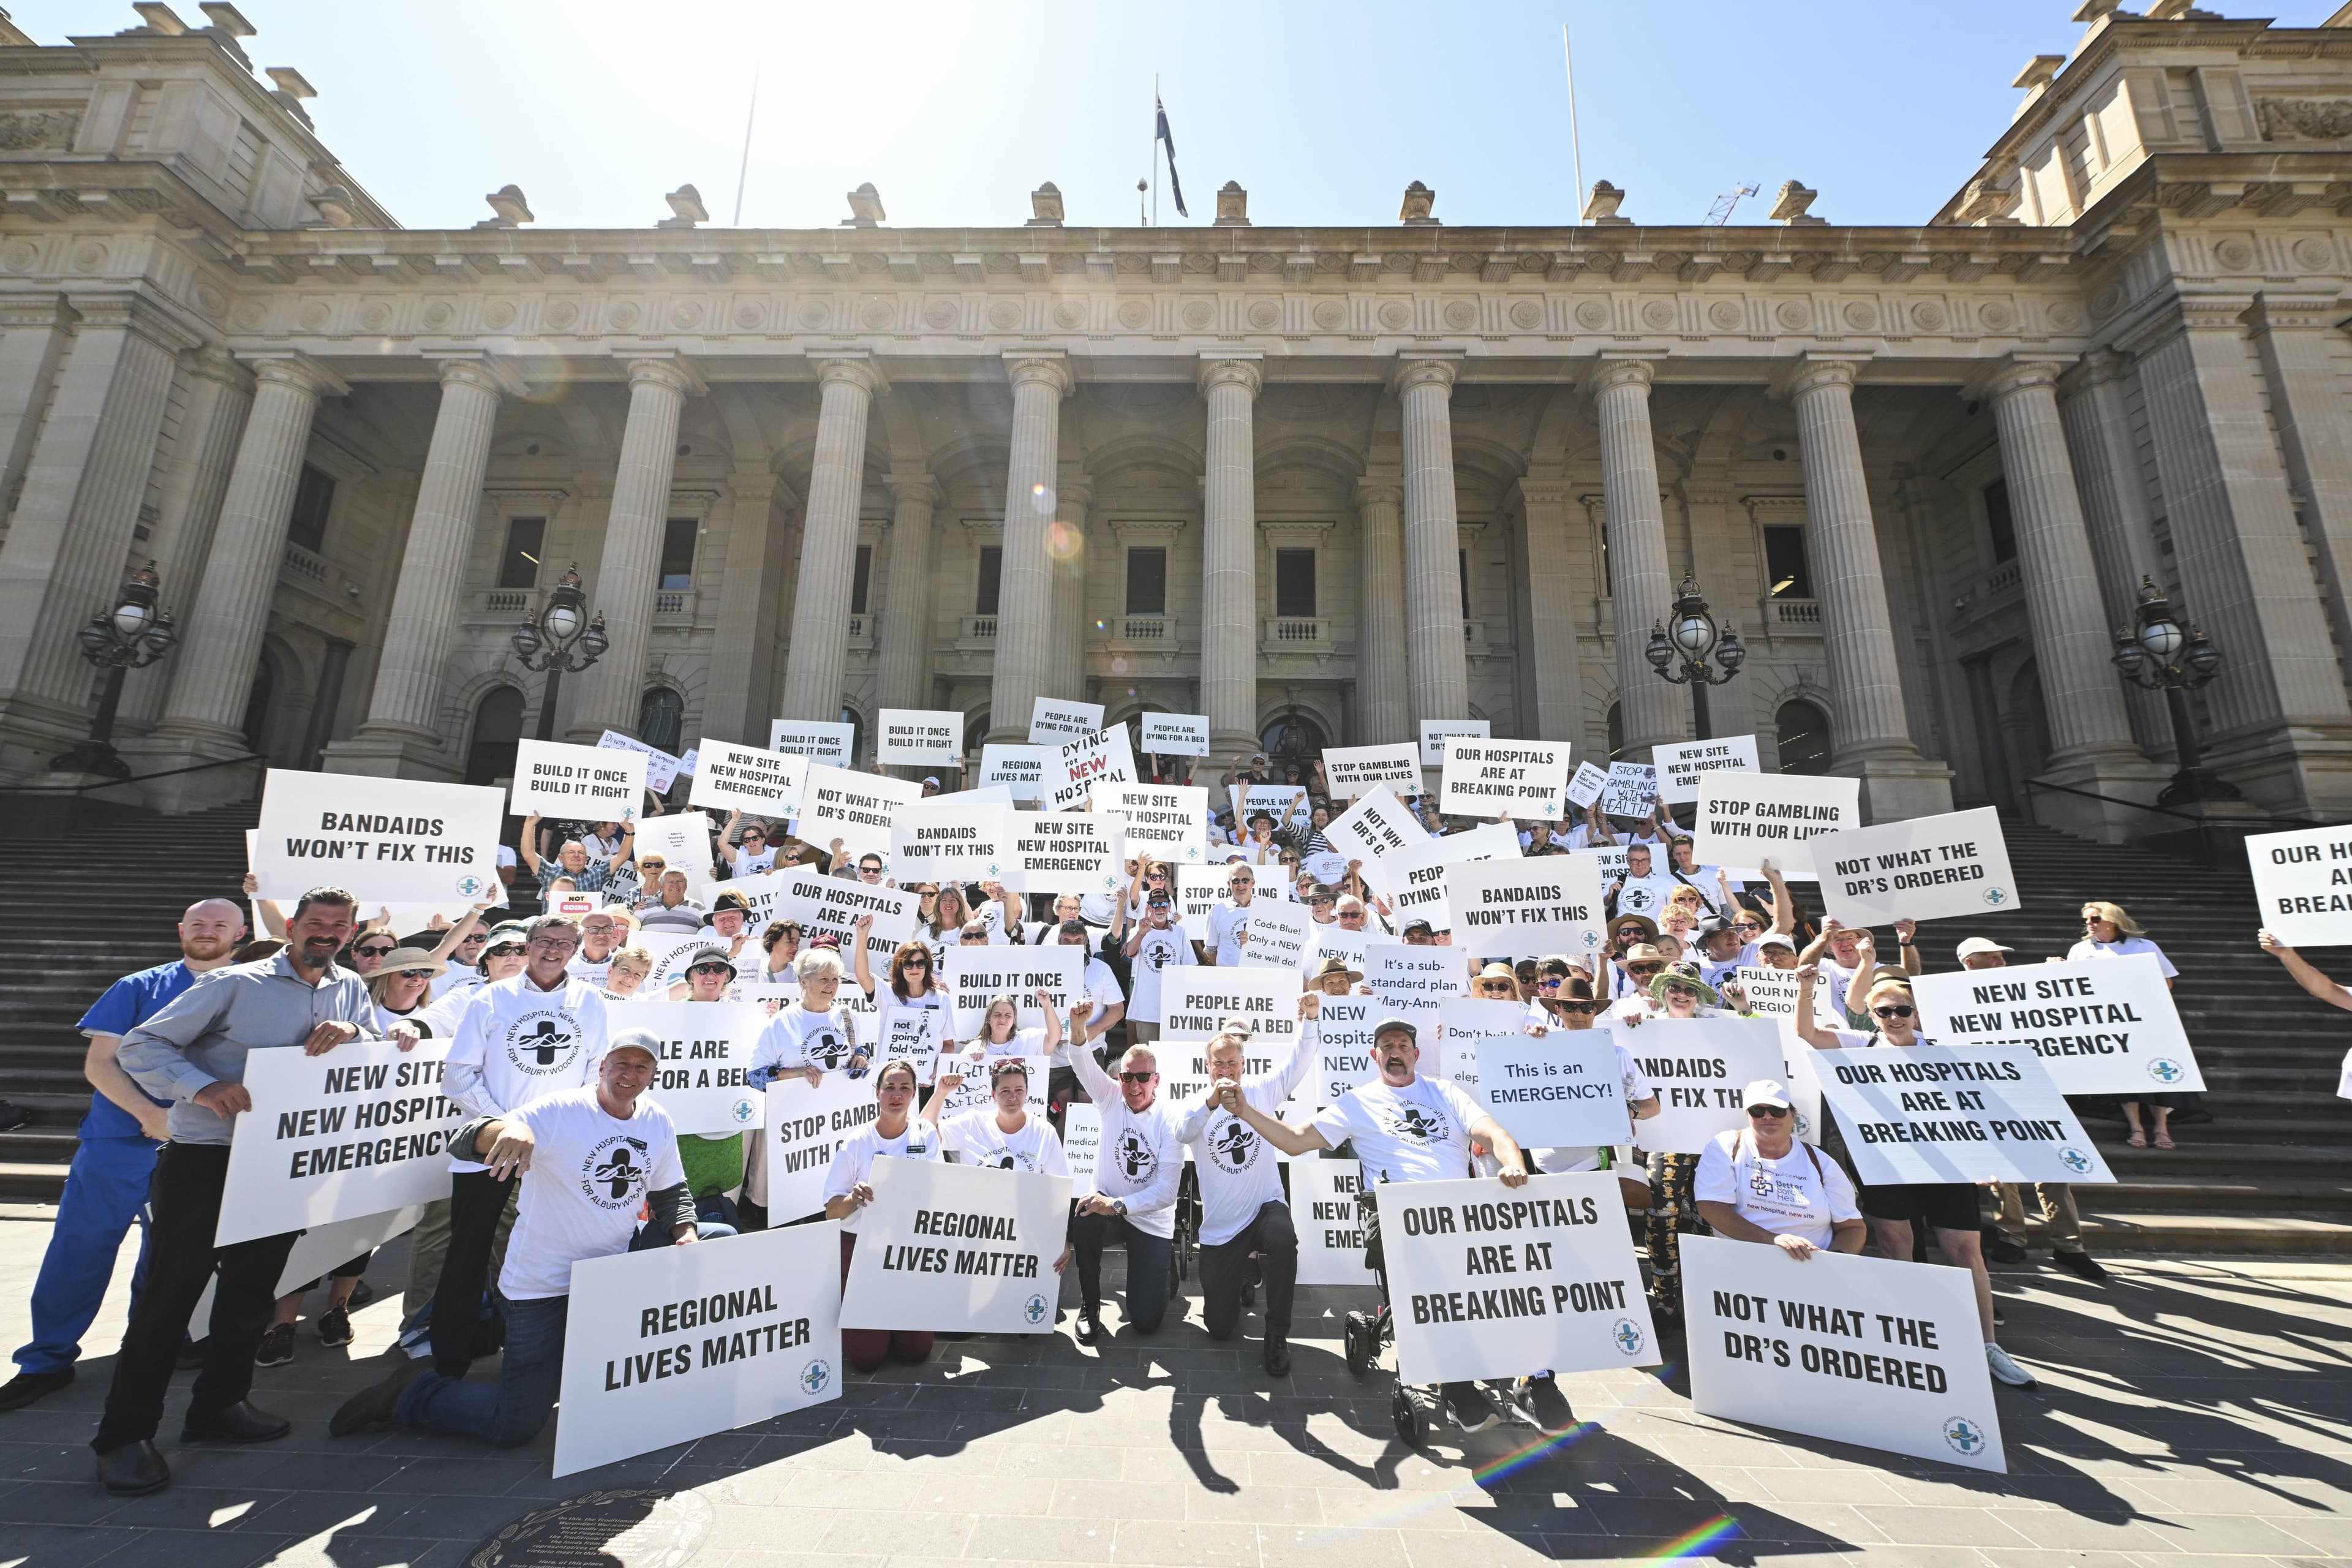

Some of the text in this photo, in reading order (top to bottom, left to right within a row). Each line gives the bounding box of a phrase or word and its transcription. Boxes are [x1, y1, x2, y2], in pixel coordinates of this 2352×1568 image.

[889, 726, 914, 734] BUILD
[928, 727, 950, 736] ONCE
[888, 738, 952, 748] BUILD IT RIGHT
[1062, 730, 1109, 758] DYING
[728, 752, 780, 770] NEW SITE
[1456, 748, 1553, 764] OUR HOSPITALS
[1679, 746, 1729, 760] NEW SITE
[1065, 758, 1078, 767] FOR
[1069, 754, 1107, 782] NEW
[1332, 760, 1410, 772] STOP GAMBLING
[1615, 766, 1642, 776] STOP
[1668, 758, 1746, 774] NEW HOSPITAL
[533, 763, 627, 783] BUILD IT ONCE
[710, 764, 791, 786] NEW HOSPITAL
[1335, 771, 1412, 783] WITH OUR LIVES
[1480, 767, 1525, 780] ARE AT
[1591, 773, 1605, 782] going
[531, 780, 630, 798] BUILD IT RIGHT
[714, 780, 783, 799] EMERGENCY
[1451, 782, 1556, 799] BREAKING POINT
[1576, 779, 1597, 792] minister!
[1607, 778, 1657, 791] GAMBLING
[1601, 798, 1649, 816] HEALTH
[1709, 800, 1839, 821] STOP GAMBLING
[321, 812, 443, 836] BANDAIDS
[918, 827, 976, 839] BANDAIDS
[1035, 822, 1093, 835] NEW SITE
[1711, 821, 1789, 839] WITH OUR
[287, 839, 474, 864] WON'T FIX THIS
[903, 844, 993, 856] WON'T FIX THIS
[1017, 840, 1109, 853] NEW HOSPITAL
[1025, 858, 1101, 871] EMERGENCY
[1835, 842, 1978, 876] NOT WHAT THE
[1845, 864, 1984, 896] DR'S ORDERED
[1482, 885, 1561, 903] BANDAIDS
[1466, 906, 1588, 925] WON'T FIX THIS
[1254, 919, 1301, 935] Code Blue!
[1249, 934, 1268, 946] Only
[1278, 940, 1301, 951] NEW
[1246, 951, 1296, 967] site will do!
[1385, 959, 1403, 970] It's
[1419, 960, 1445, 971] sub-
[1371, 978, 1457, 992] standard plan
[1973, 977, 2095, 1004] NEW SITE
[506, 1023, 519, 1041] NEW
[557, 1012, 576, 1024] NEW
[573, 1024, 581, 1039] SITE
[1950, 1003, 2142, 1033] NEW HOSPITAL
[506, 1046, 580, 1076] FOR ALBURY WODONGA
[1504, 1062, 1583, 1077] This is an
[324, 1065, 389, 1094] NEW
[1835, 1061, 2021, 1084] OUR HOSPITALS
[1491, 1084, 1612, 1103] EMERGENCY!
[1901, 1091, 1985, 1111] ARE AT
[276, 1106, 347, 1140] NEW
[1857, 1120, 2067, 1144] BREAKING POINT
[1776, 1180, 1803, 1191] Better
[914, 1210, 1016, 1241] REGIONAL
[1403, 1197, 1597, 1236] OUR HOSPITALS
[883, 1245, 1038, 1278] LIVES MATTER
[1467, 1242, 1552, 1275] ARE AT
[1411, 1280, 1626, 1324] BREAKING POINT
[640, 1284, 778, 1339] REGIONAL
[1713, 1291, 1939, 1350] NOT WHAT THE
[605, 1317, 811, 1392] LIVES MATTER
[1724, 1331, 1948, 1395] DR'S ORDERED
